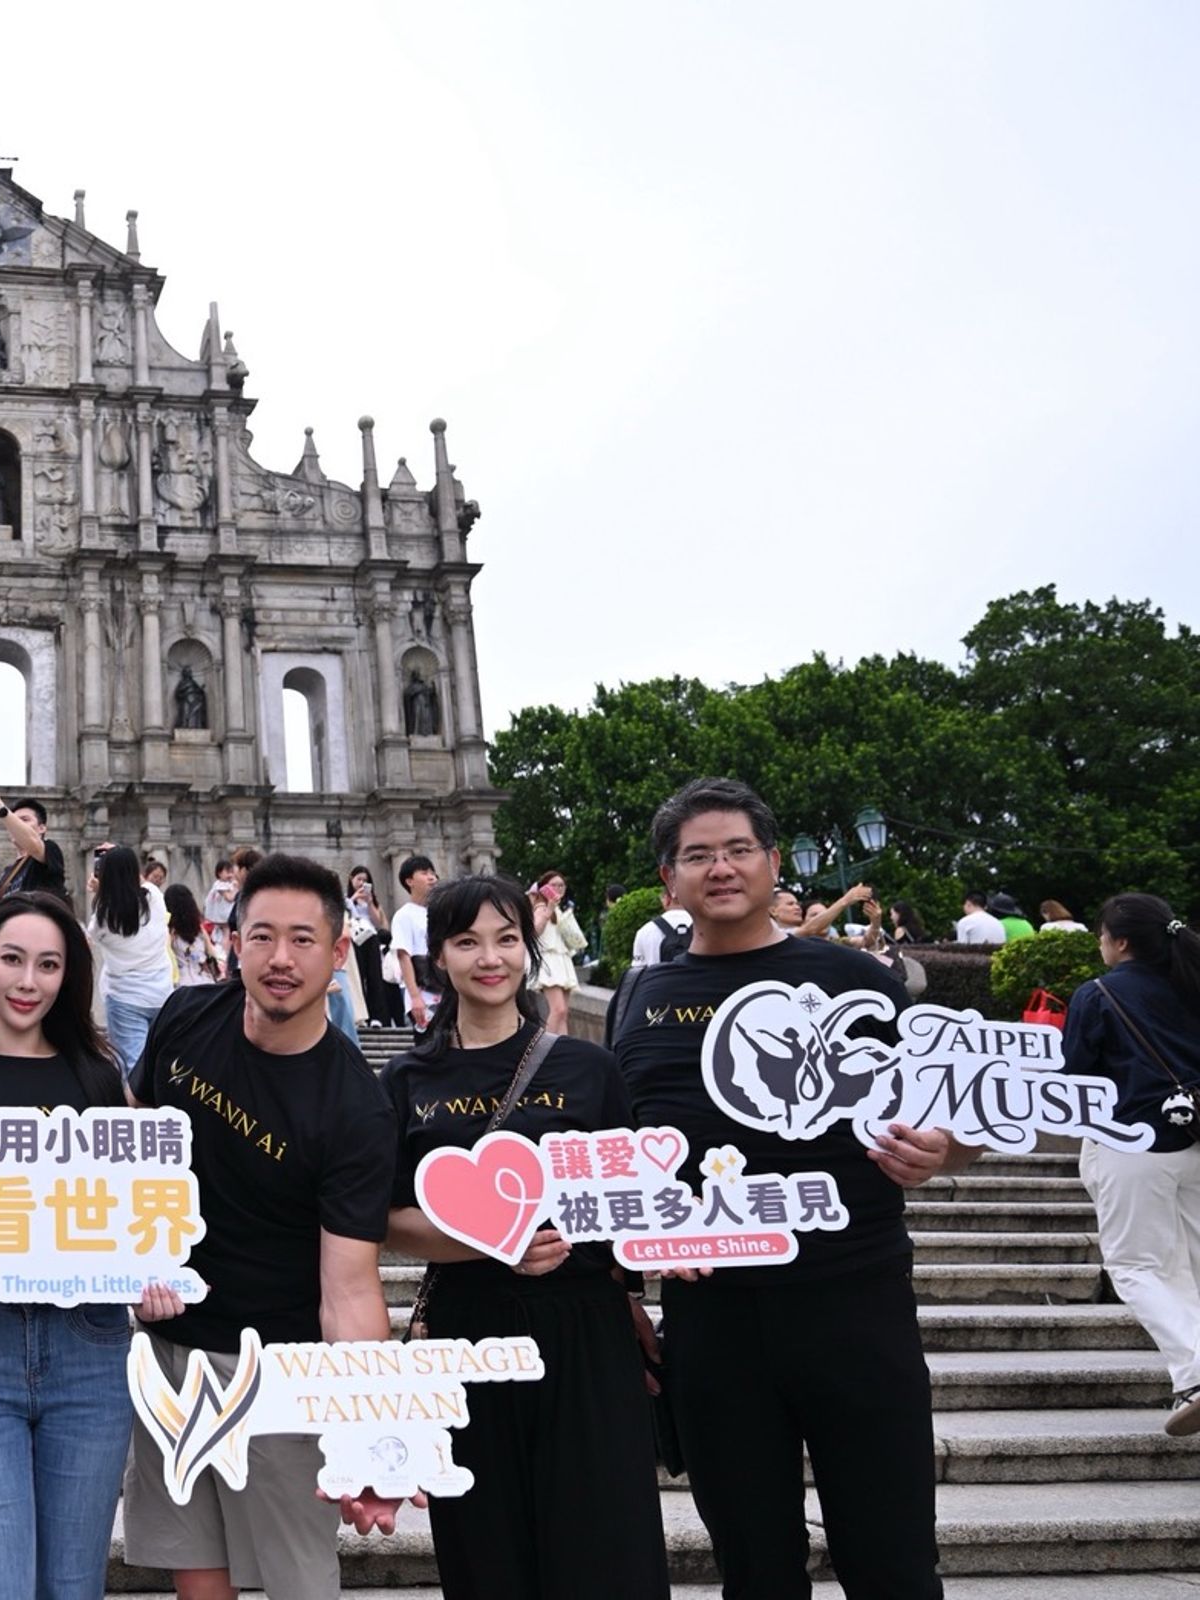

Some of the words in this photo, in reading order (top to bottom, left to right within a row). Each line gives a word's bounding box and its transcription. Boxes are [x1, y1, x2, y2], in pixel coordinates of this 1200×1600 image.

[908, 1013, 1053, 1060] TAIPEI
[190, 1076, 258, 1137] WANN
[256, 1132, 287, 1161] Ai
[534, 1092, 565, 1110] Ai
[910, 1060, 1145, 1143] MUSE
[548, 1134, 639, 1180] 讓愛
[558, 1179, 841, 1235] 被更多人看見
[632, 1239, 663, 1258] Let
[667, 1238, 713, 1257] Love
[718, 1235, 778, 1255] Shine.
[2, 1275, 86, 1298] Through
[92, 1275, 142, 1293] Little
[148, 1275, 198, 1294] es.
[275, 1348, 402, 1379] WANN
[412, 1345, 537, 1375] STAGE
[297, 1391, 464, 1424] TAIWAN
